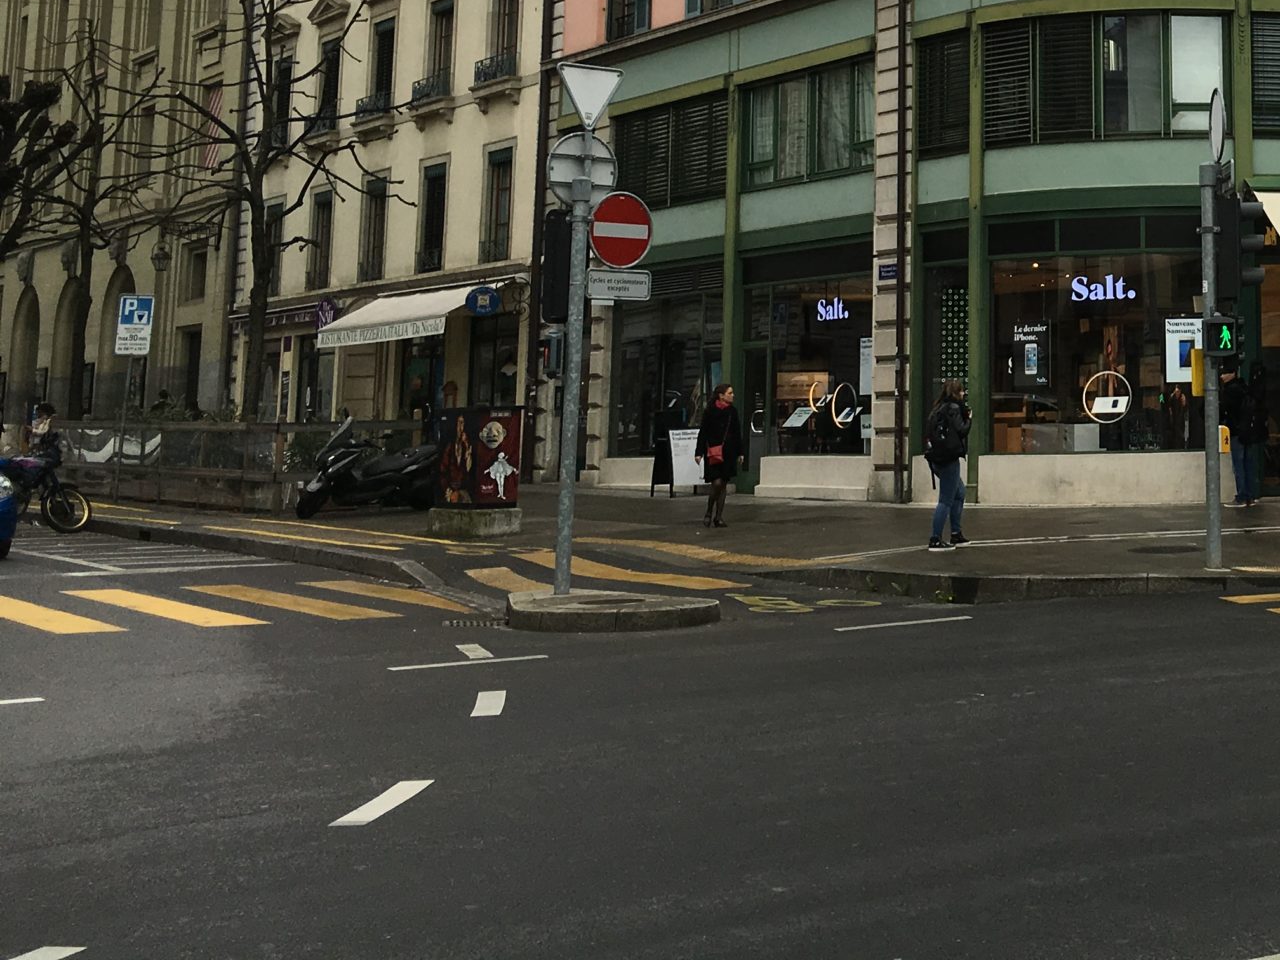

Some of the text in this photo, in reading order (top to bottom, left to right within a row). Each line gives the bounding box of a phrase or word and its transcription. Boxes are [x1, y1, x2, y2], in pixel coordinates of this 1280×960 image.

[590, 276, 606, 284] Cycles
[1071, 274, 1136, 301] Salt.
[125, 299, 138, 315] P
[817, 296, 849, 322] Salt.
[320, 330, 357, 346] RISTORANTE
[358, 326, 387, 343] PIZZERIA
[387, 323, 409, 339] ITALIA
[1014, 324, 1047, 333] Le dernier
[1014, 333, 1039, 342] iPhone.
